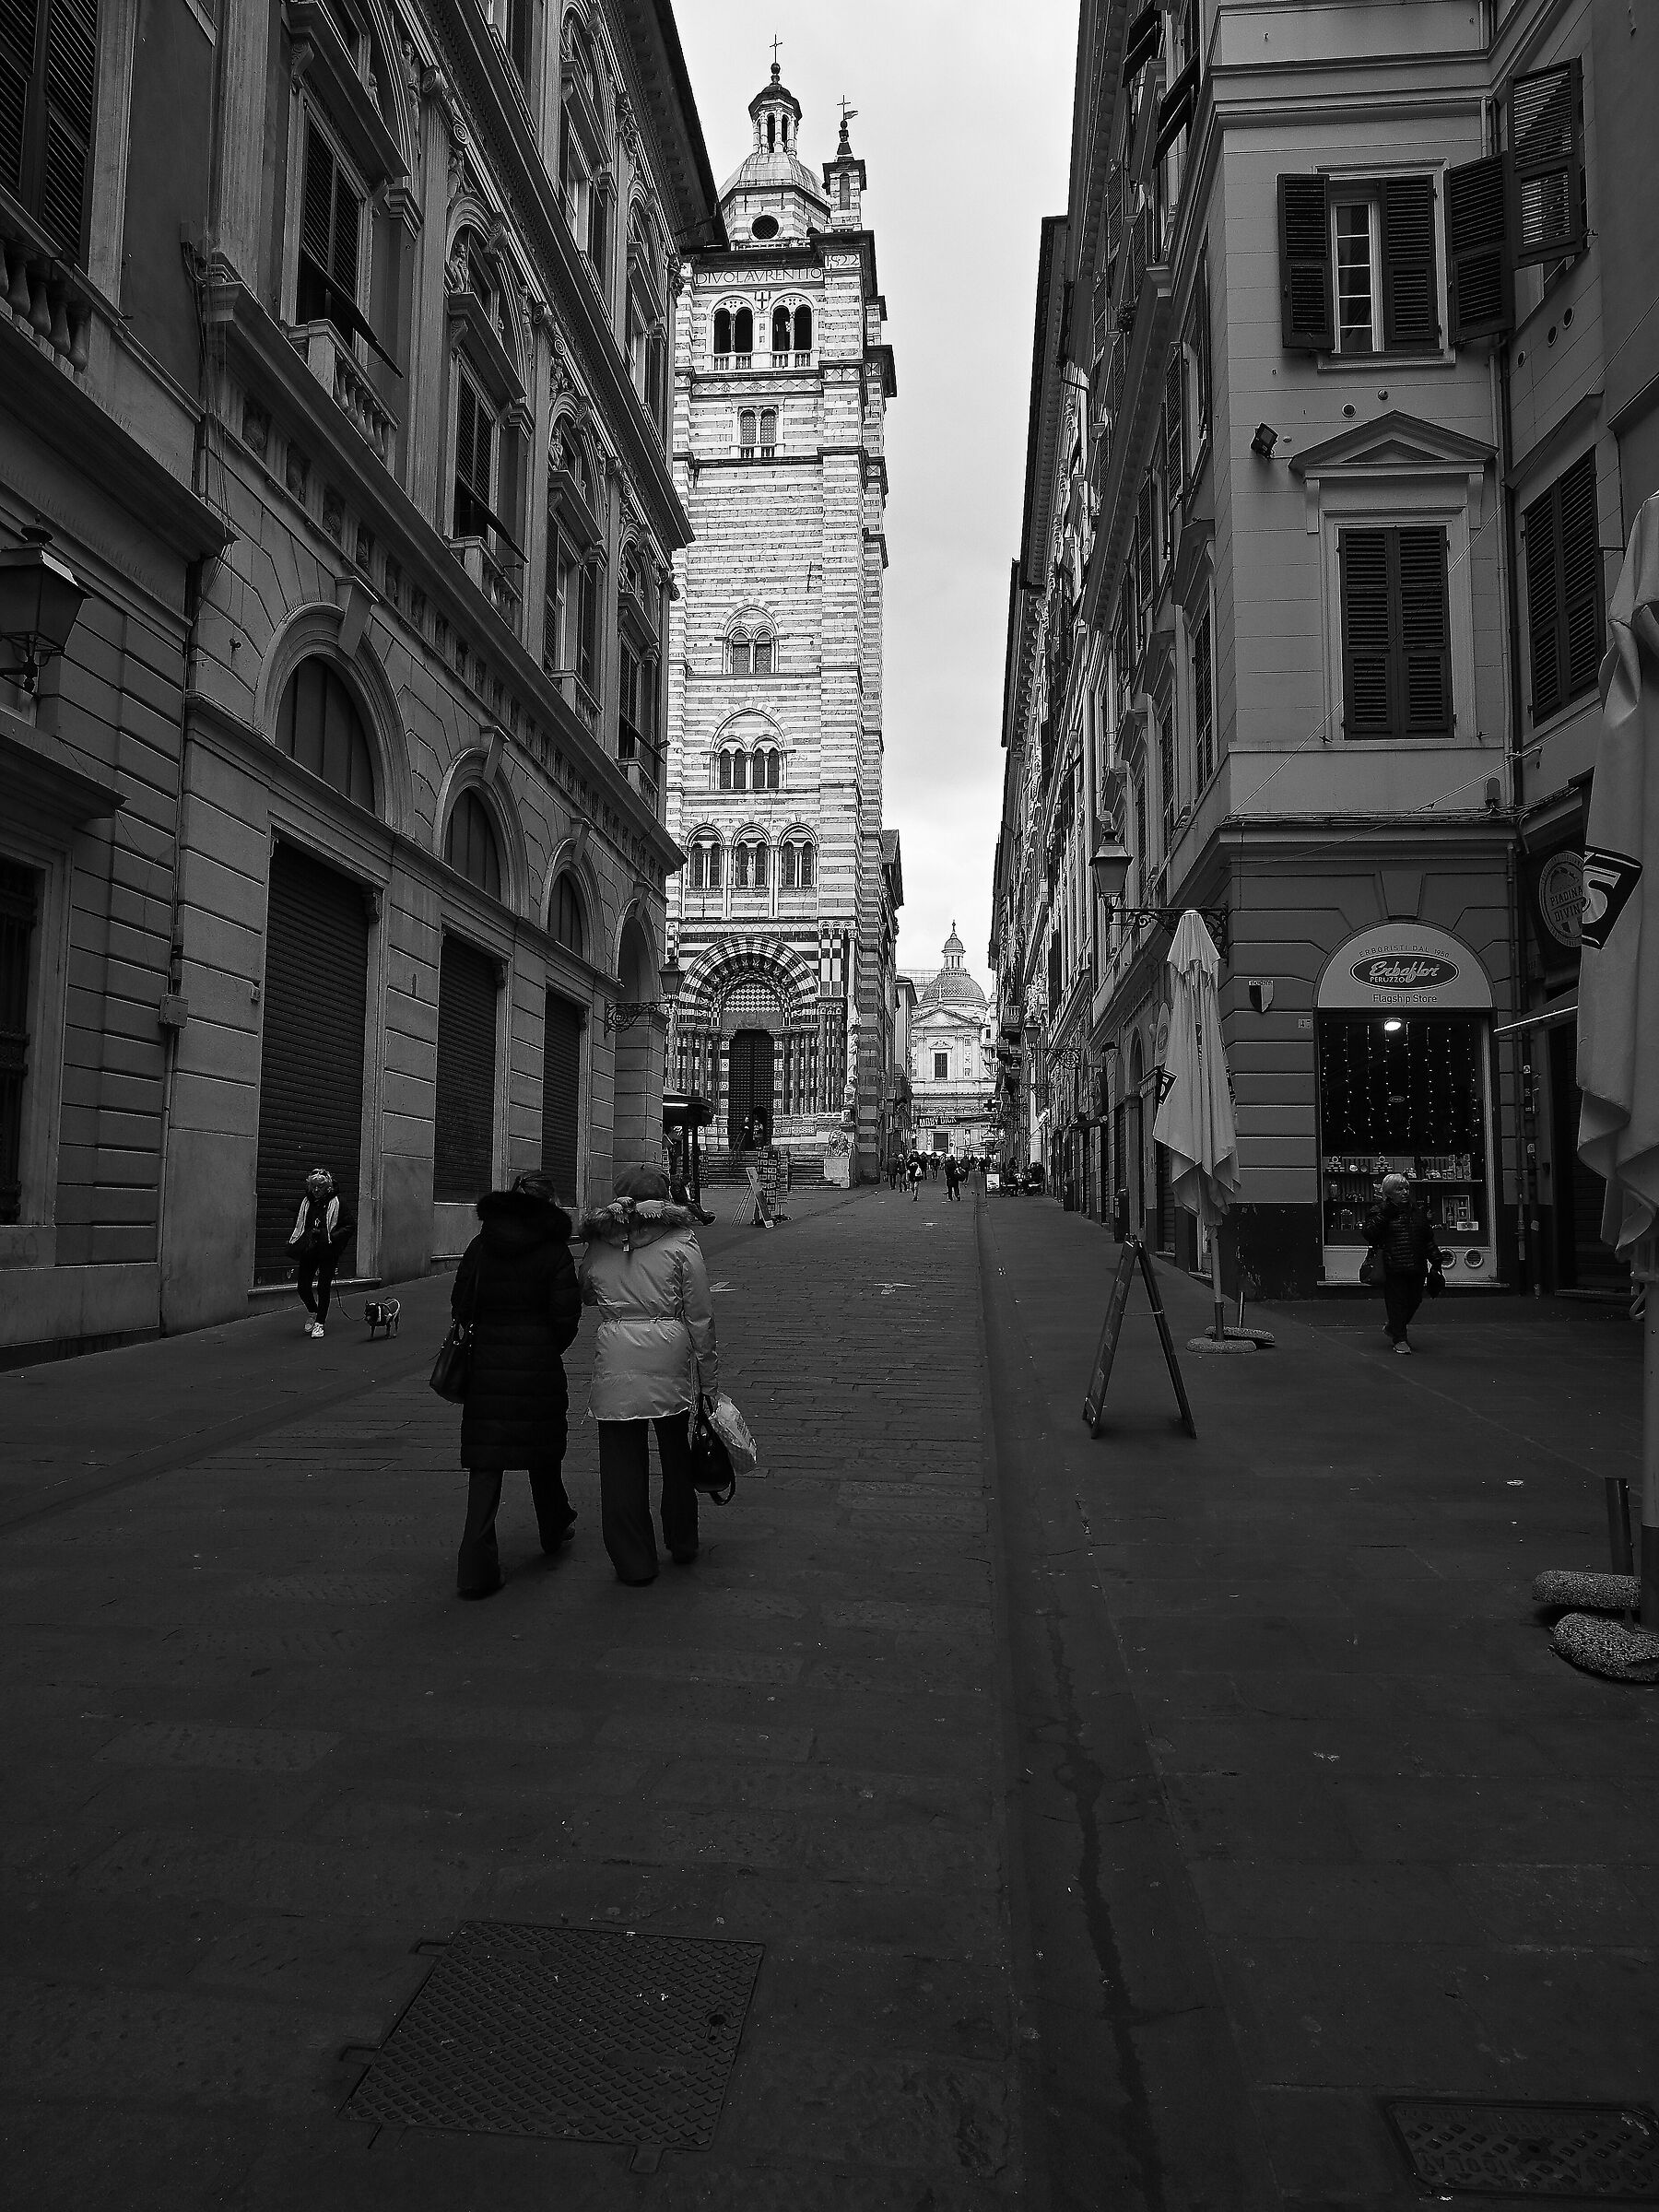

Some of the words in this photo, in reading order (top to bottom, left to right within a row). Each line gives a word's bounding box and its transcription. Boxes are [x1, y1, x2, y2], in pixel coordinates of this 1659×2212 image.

[828, 253, 859, 267] 1522
[1550, 886, 1583, 906] PIADINA
[1554, 901, 1584, 922] DIVIN
[1359, 945, 1407, 958] ERBORISTI
[1434, 948, 1450, 959] 1950
[1372, 994, 1411, 1005] Flagship
[1413, 994, 1438, 1004] Store
[919, 1116, 938, 1127] MOBY
[939, 1115, 957, 1124] DICK
